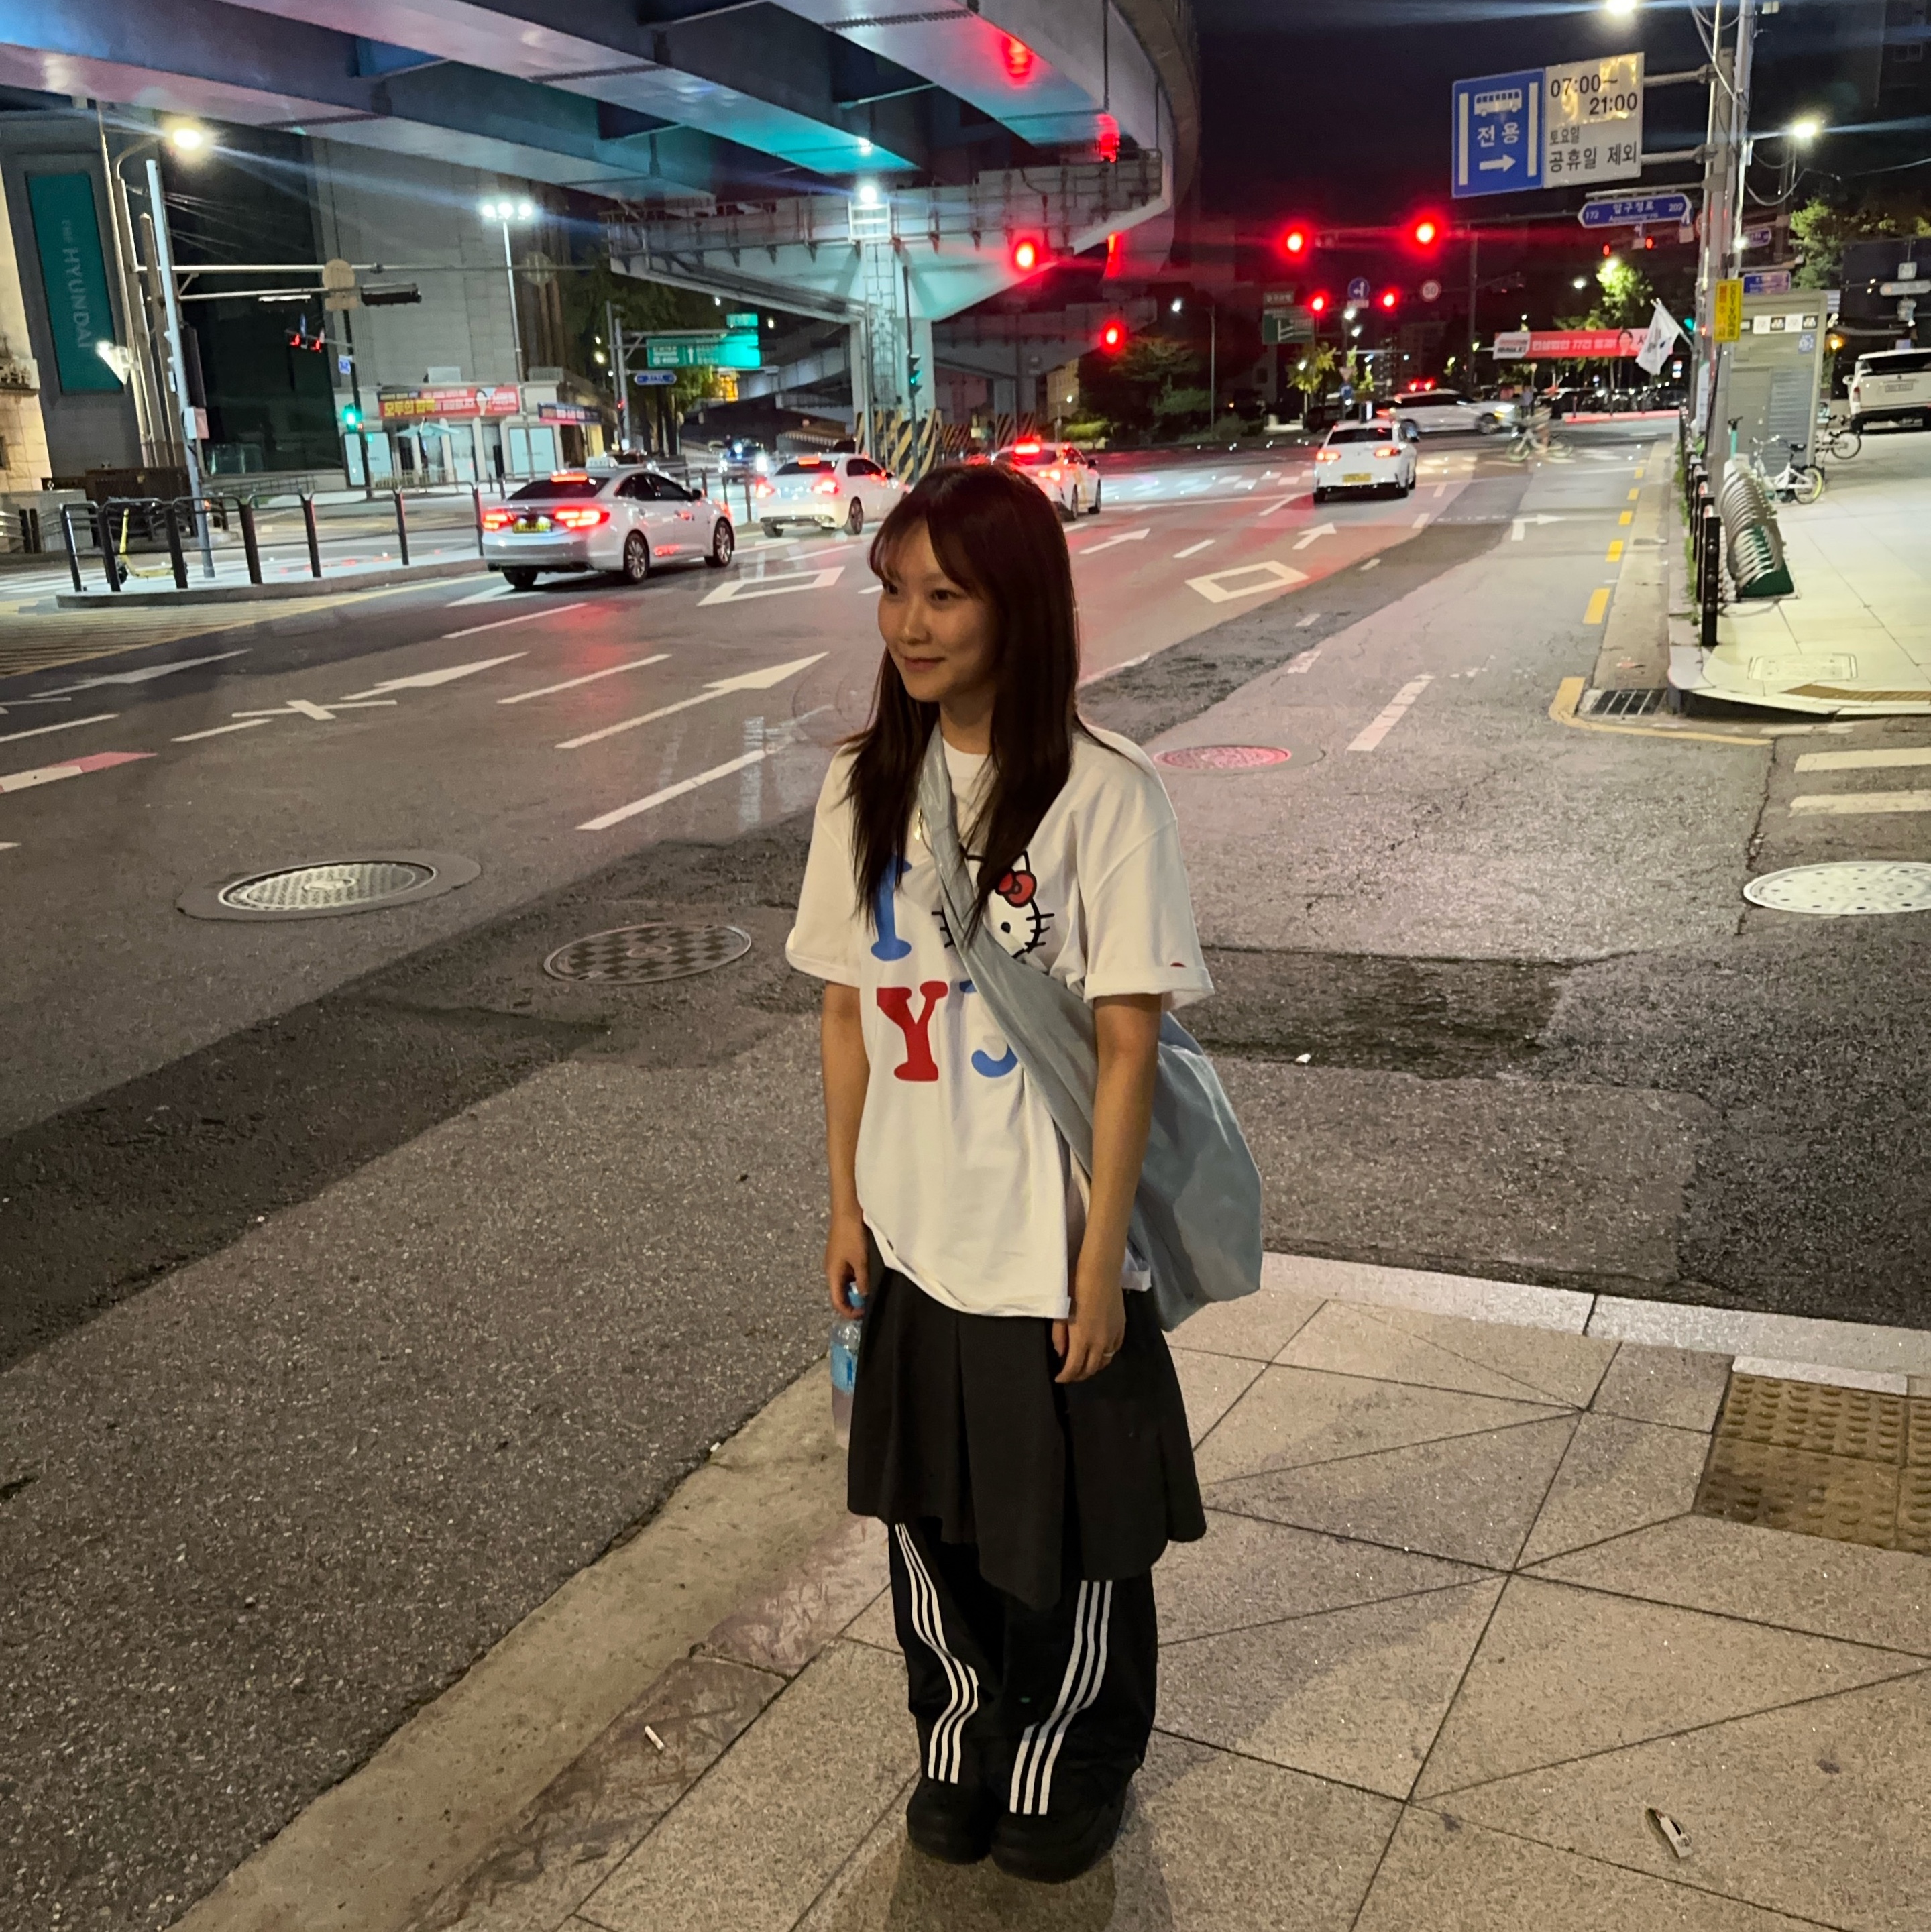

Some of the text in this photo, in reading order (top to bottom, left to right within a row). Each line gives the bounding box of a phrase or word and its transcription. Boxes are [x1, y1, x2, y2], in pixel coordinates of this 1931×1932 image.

[1589, 93, 1638, 116] 21:00
[1549, 127, 1580, 146] 토요일
[1549, 141, 1637, 173] 공휴일 제외
[62, 247, 93, 348] HYUNDAI
[1425, 285, 1436, 294] 50
